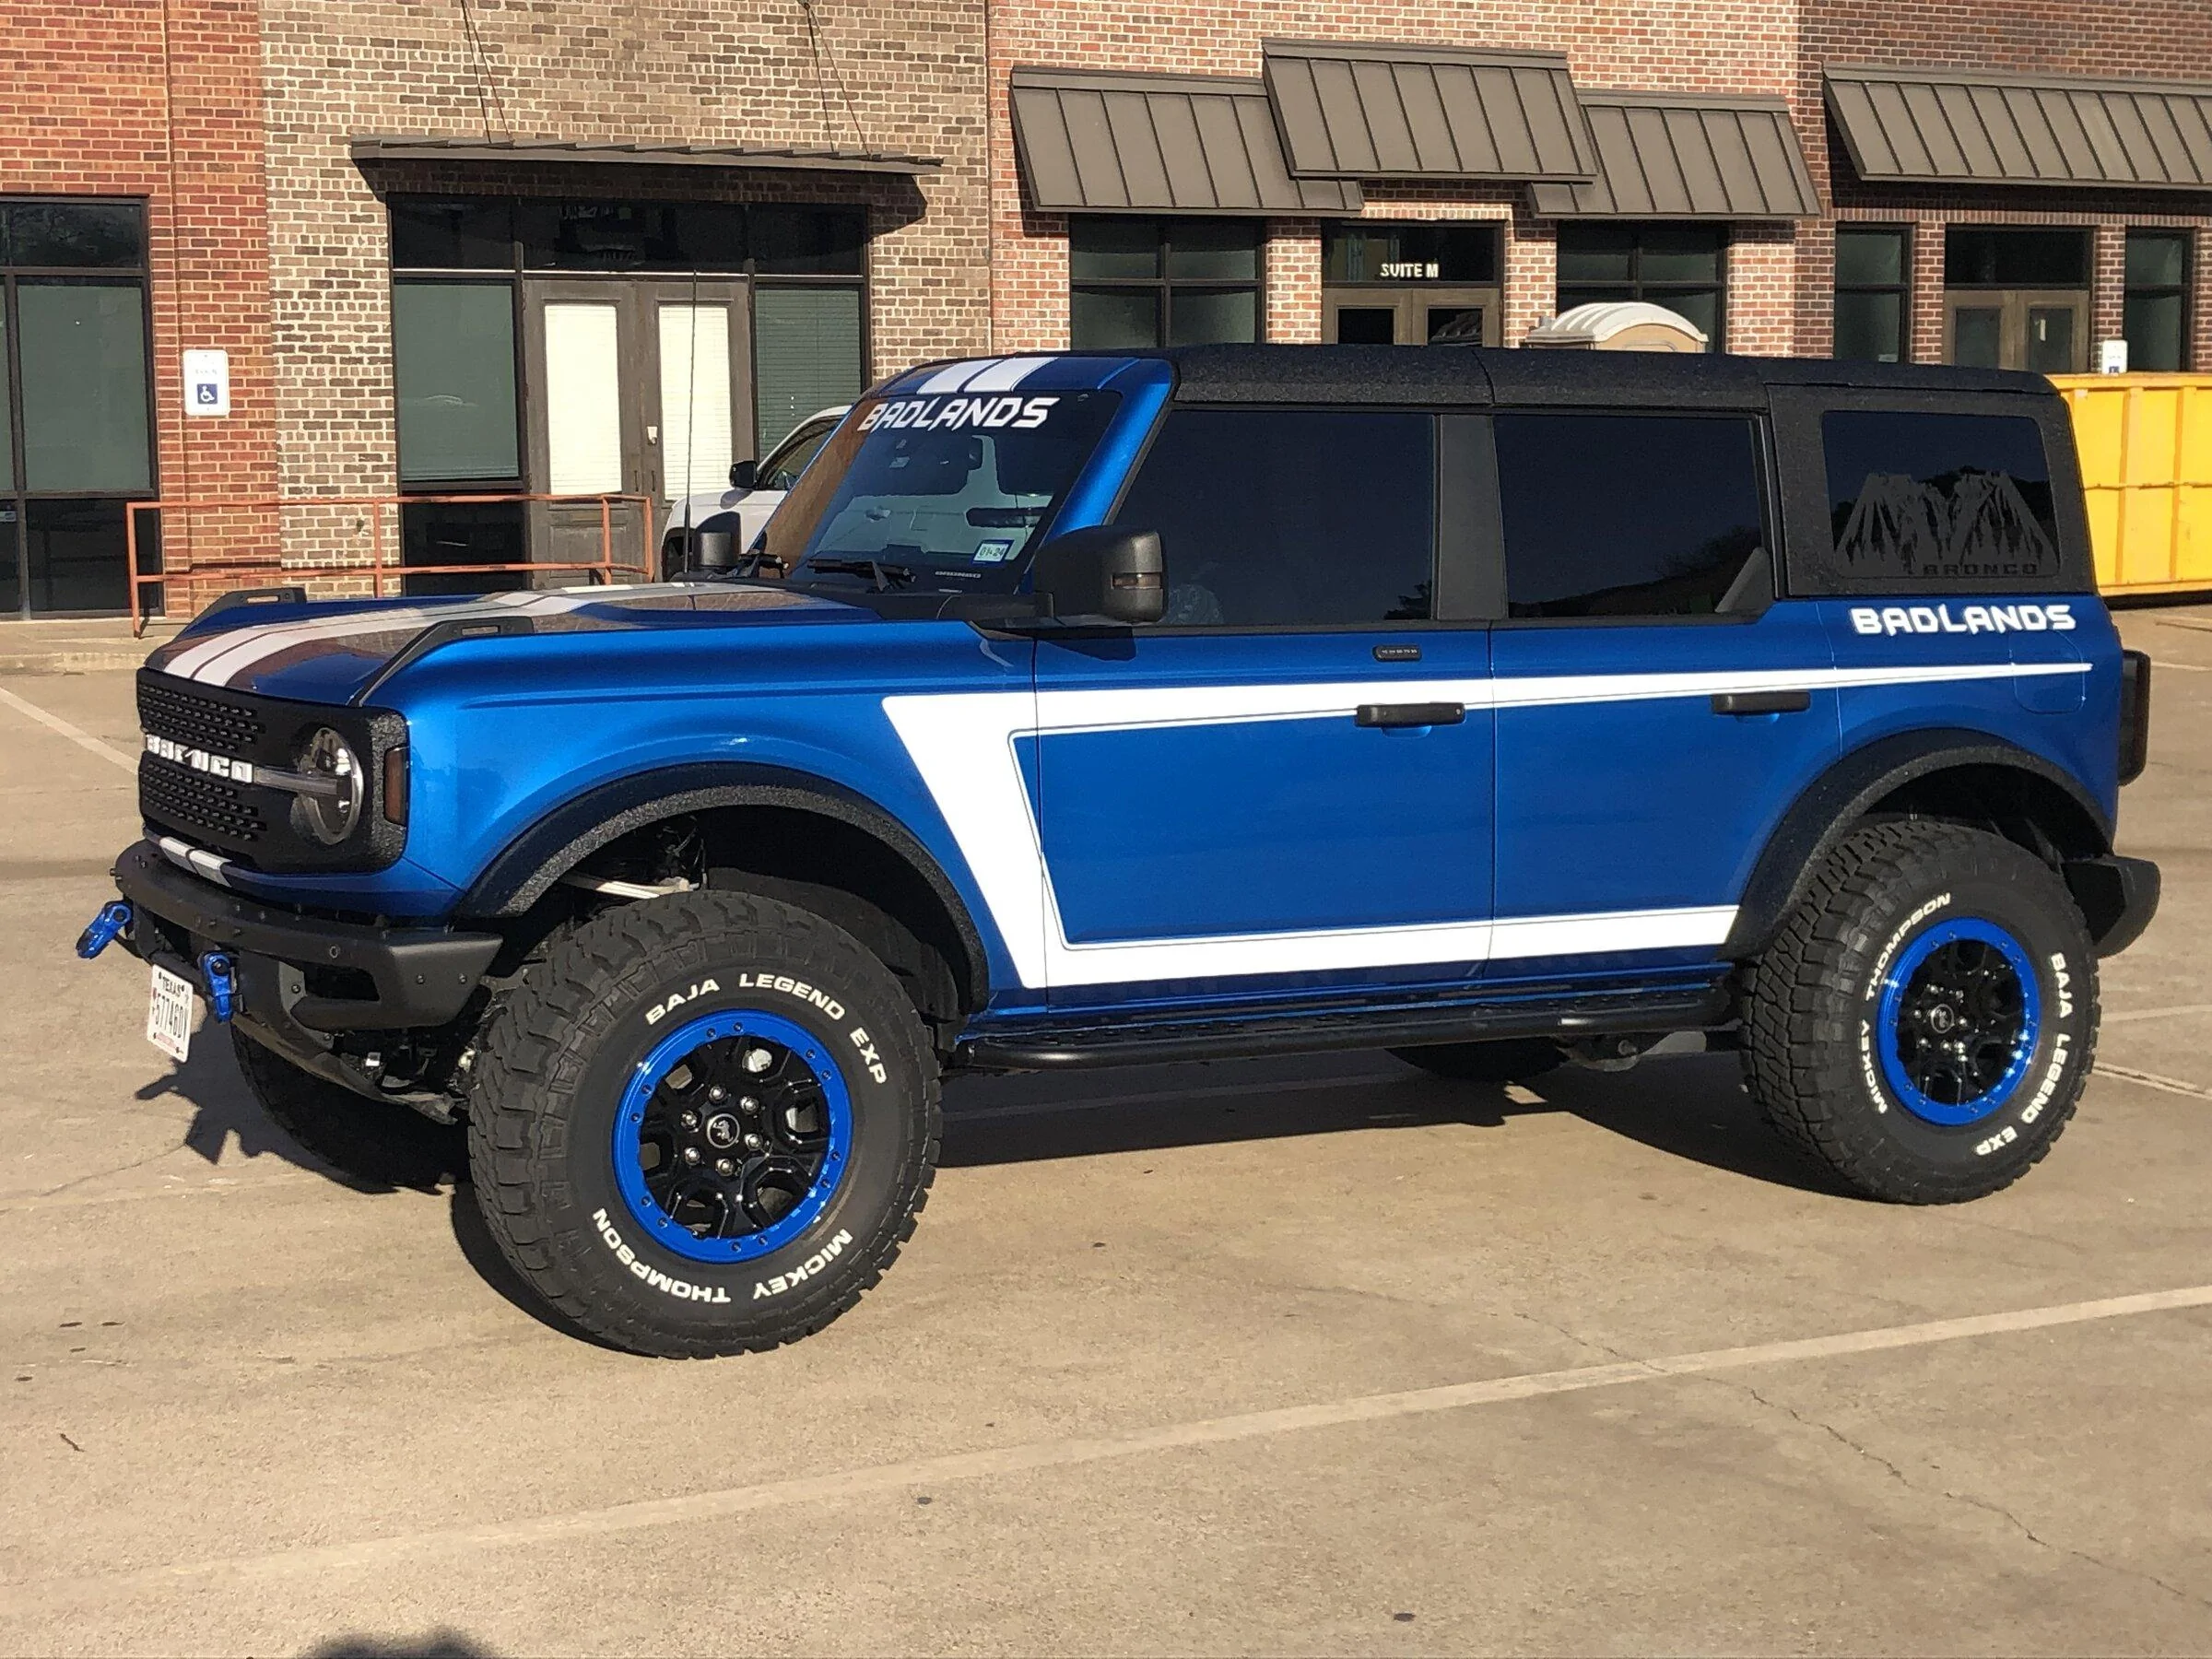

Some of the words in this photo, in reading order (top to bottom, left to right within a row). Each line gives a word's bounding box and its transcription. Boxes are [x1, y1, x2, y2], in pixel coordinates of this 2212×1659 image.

[1380, 263, 1423, 277] SUITE
[1426, 263, 1439, 277] M
[857, 396, 1060, 432] BADLANDS
[1923, 563, 2039, 575] BRONCO
[1850, 603, 2077, 637] BADLANDS
[1866, 892, 1951, 1001] THOMPSON
[162, 976, 182, 997] TEXAS
[2052, 952, 2073, 1018] BAJA
[645, 979, 720, 1025] BAJA
[739, 973, 846, 1020] LEGEND
[850, 1027, 888, 1084] EXP
[1860, 1019, 1888, 1113] MICKEY
[2021, 1033, 2071, 1124] LEGEND
[1974, 1125, 2018, 1156] EXP
[593, 1207, 731, 1303] THOMPSON
[753, 1228, 853, 1300] MICKEY
